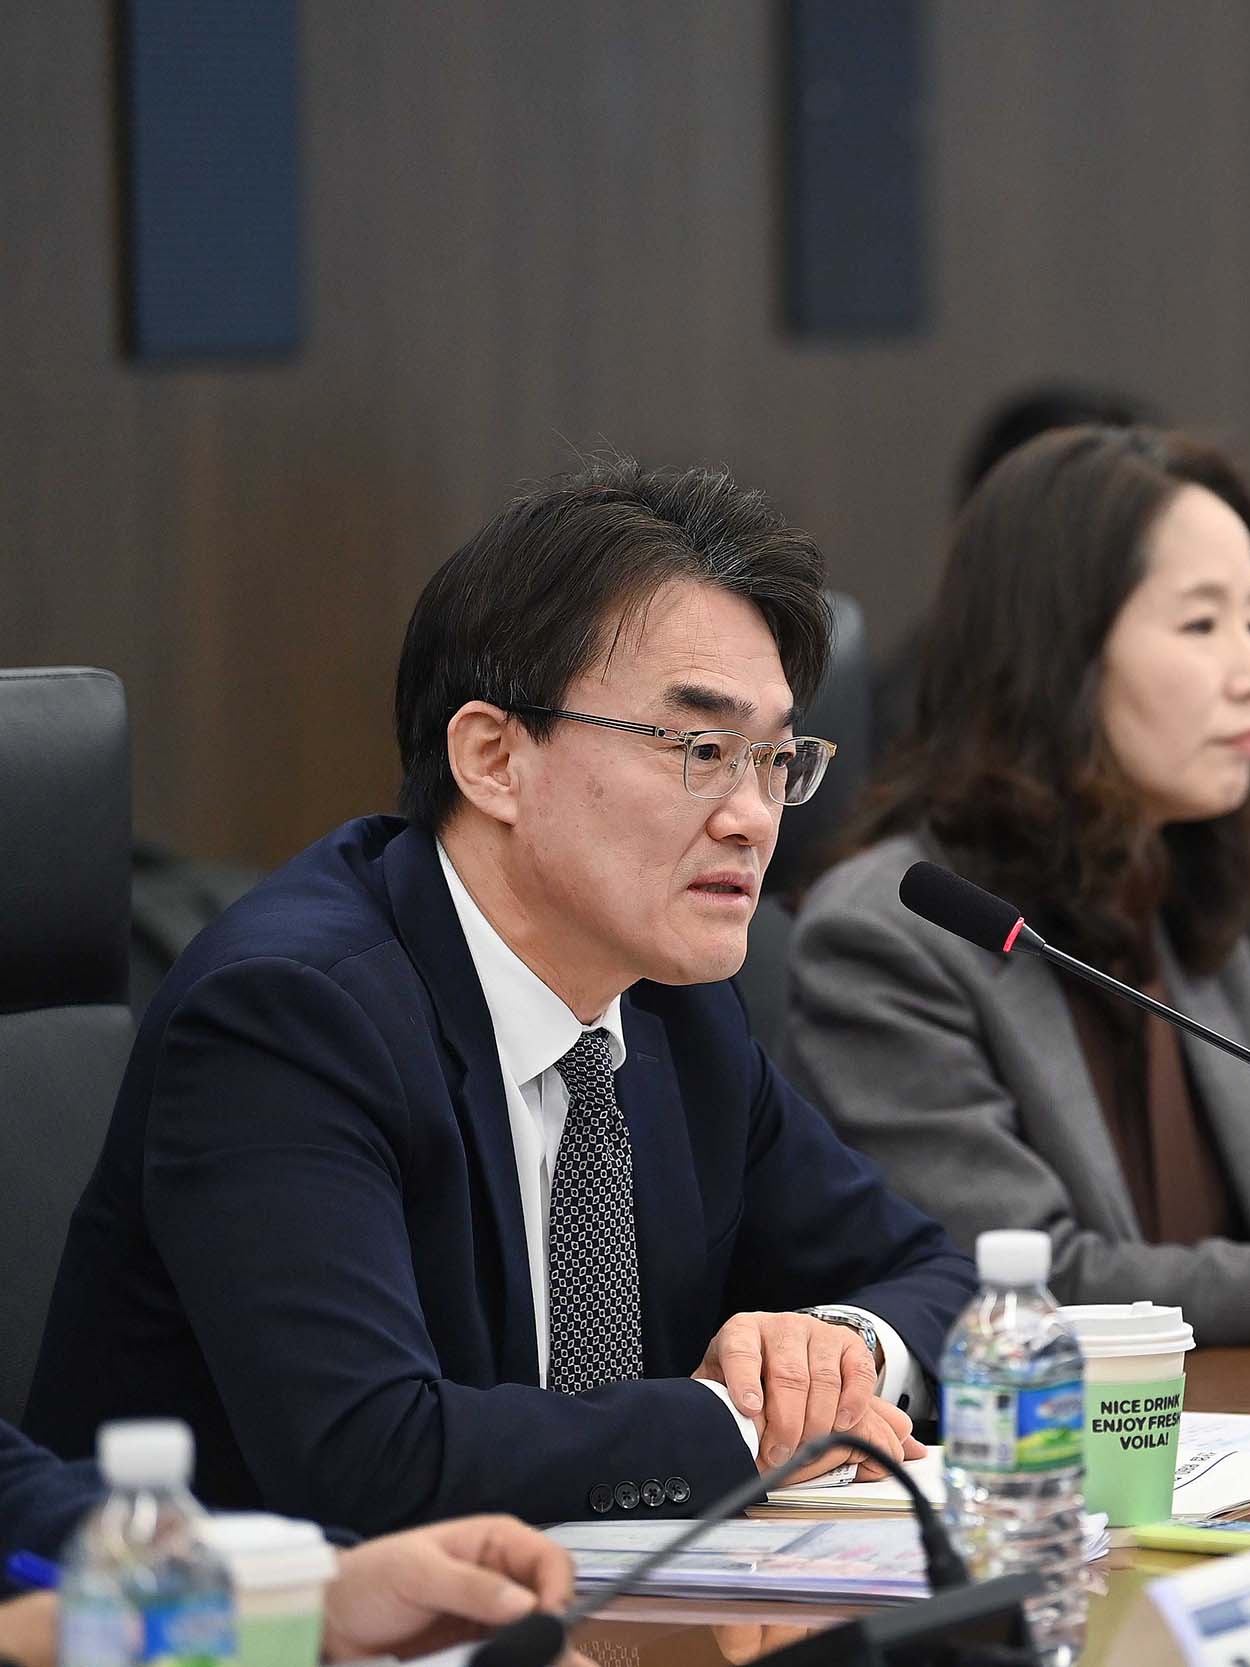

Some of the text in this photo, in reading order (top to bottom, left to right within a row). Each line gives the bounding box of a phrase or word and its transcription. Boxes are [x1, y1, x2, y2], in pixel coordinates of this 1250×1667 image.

[1100, 1400, 1140, 1415] NICE
[1144, 1394, 1180, 1412] DRINK
[1092, 1417, 1147, 1433] ENJOY
[1120, 1432, 1169, 1450] VOILA!
